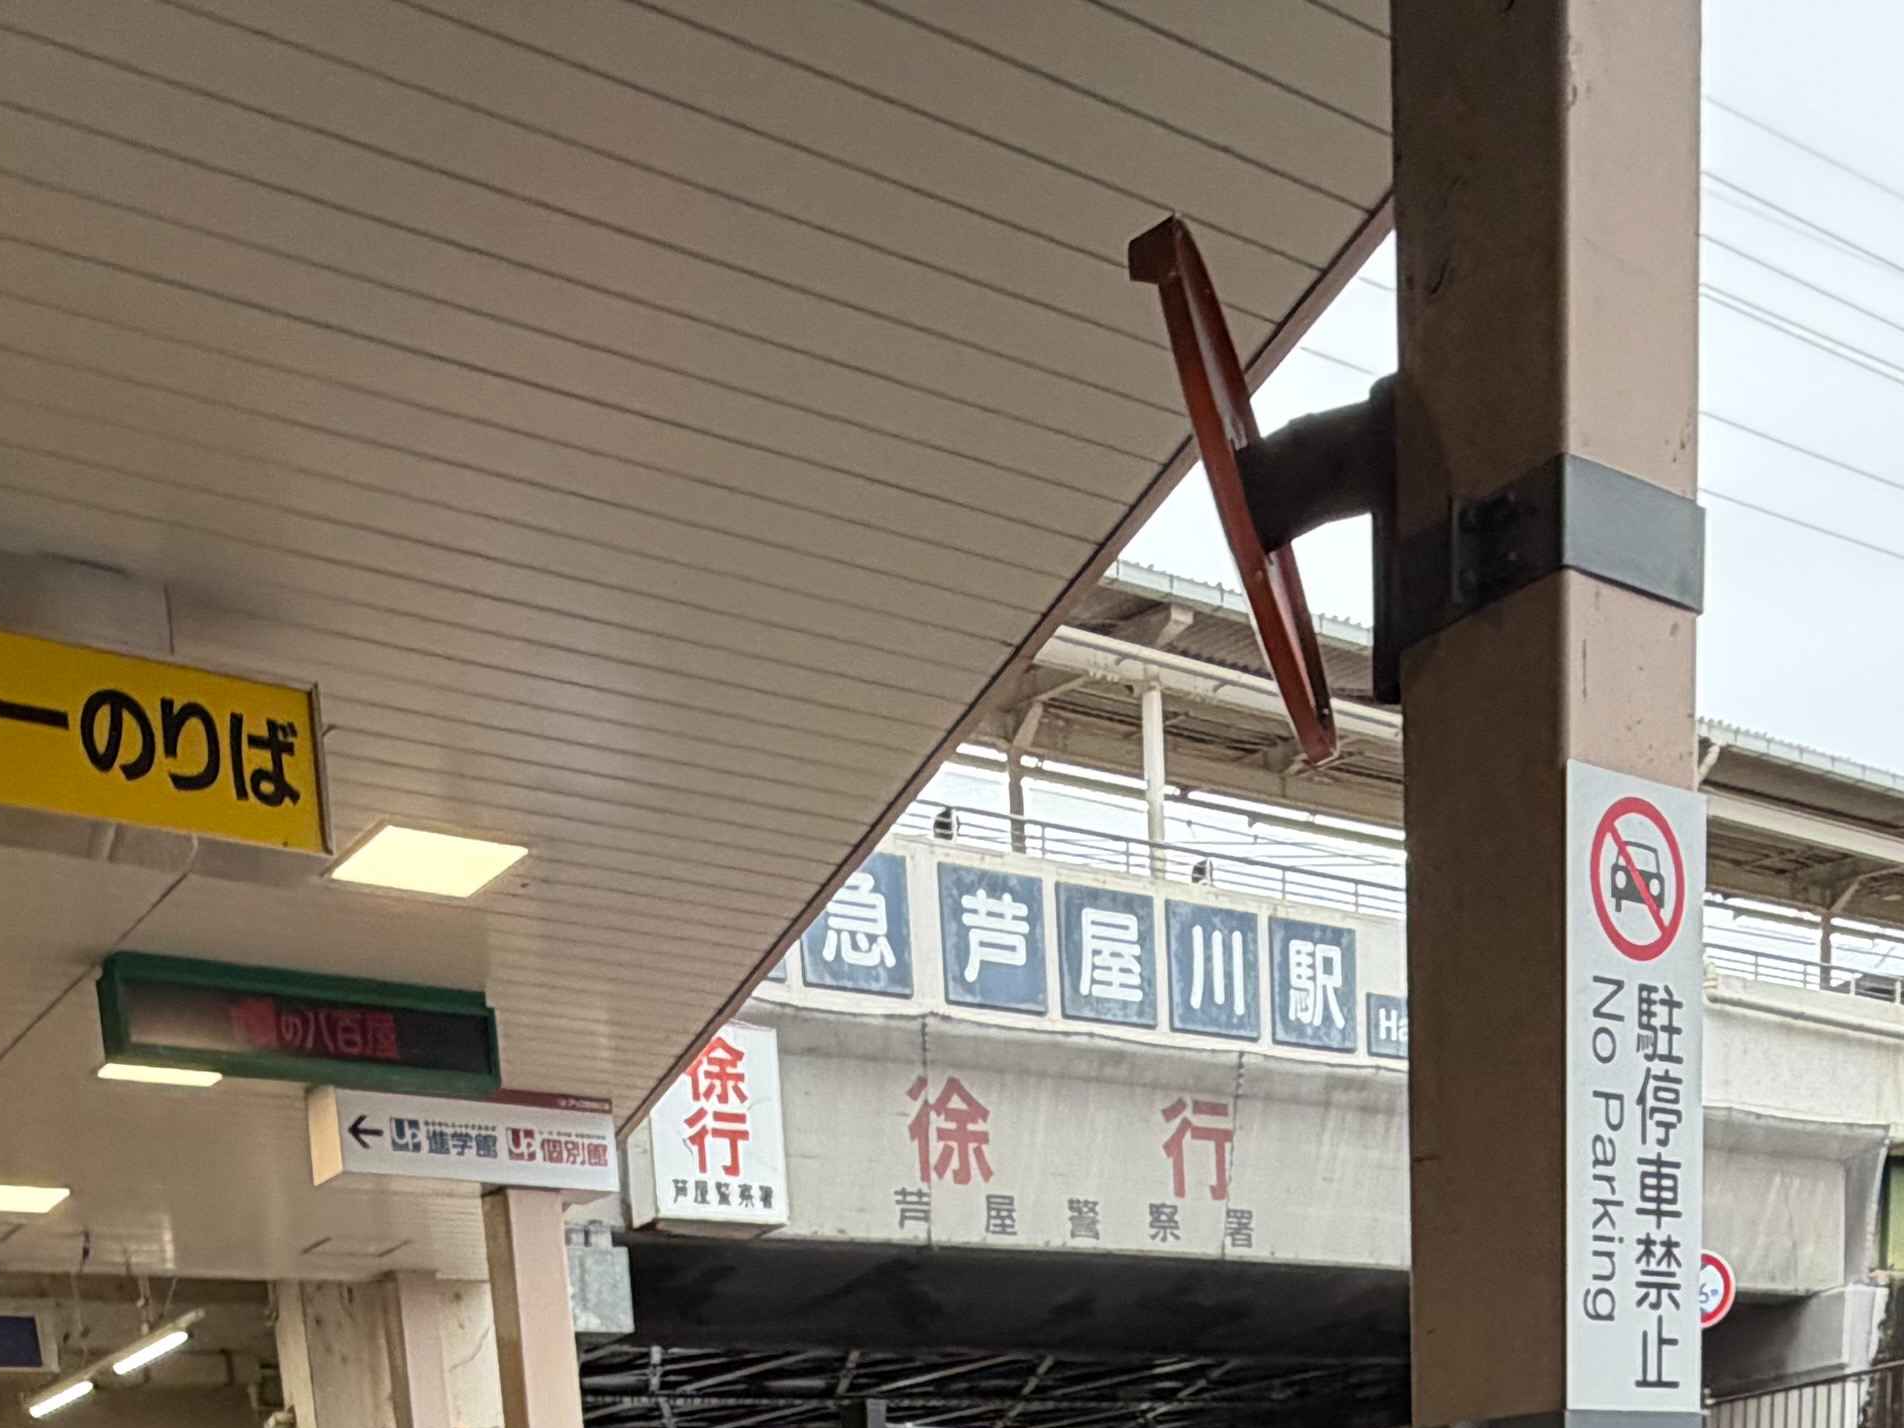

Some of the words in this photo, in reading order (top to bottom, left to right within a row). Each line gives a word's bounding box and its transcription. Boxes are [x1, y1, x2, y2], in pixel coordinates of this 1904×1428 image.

[1591, 975, 1626, 1066] No
[683, 1036, 751, 1177] 徐行
[907, 1075, 1236, 1202] 徐行
[671, 1178, 775, 1210] 芦屋警察署
[894, 1187, 1257, 1250] 芦屋警察署
[1584, 1091, 1626, 1324] Parking
[1634, 981, 1684, 1390] 駐停車禁止
